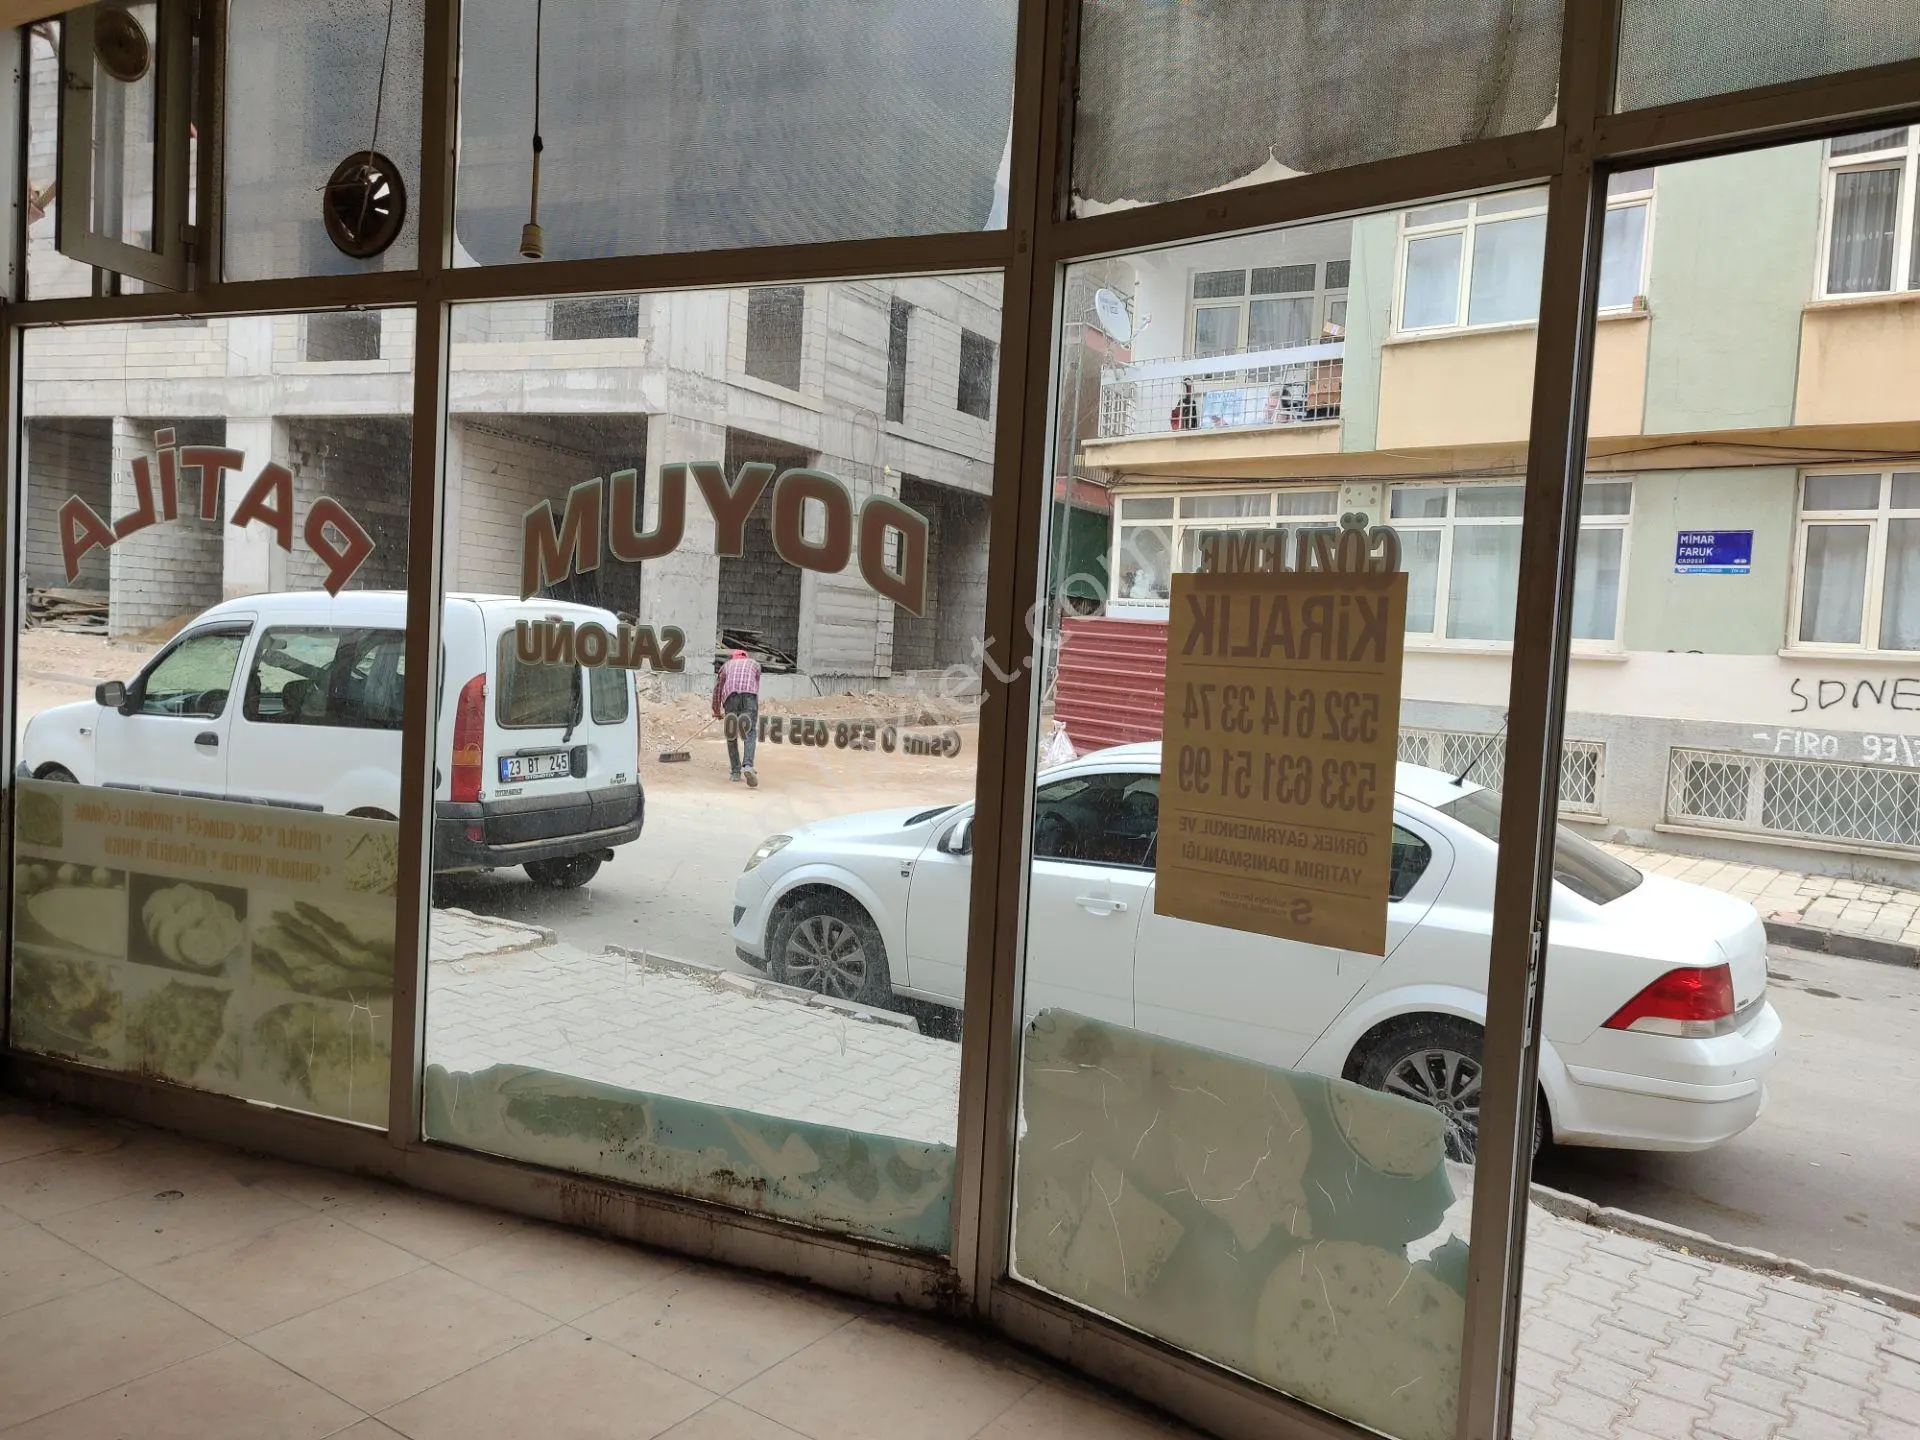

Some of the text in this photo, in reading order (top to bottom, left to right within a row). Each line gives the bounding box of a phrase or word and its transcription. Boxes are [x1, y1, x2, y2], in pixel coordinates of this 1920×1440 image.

[1680, 534, 1715, 544] MİMAR
[1679, 547, 1713, 556] FARUK
[509, 754, 567, 775] 23 BT 245
